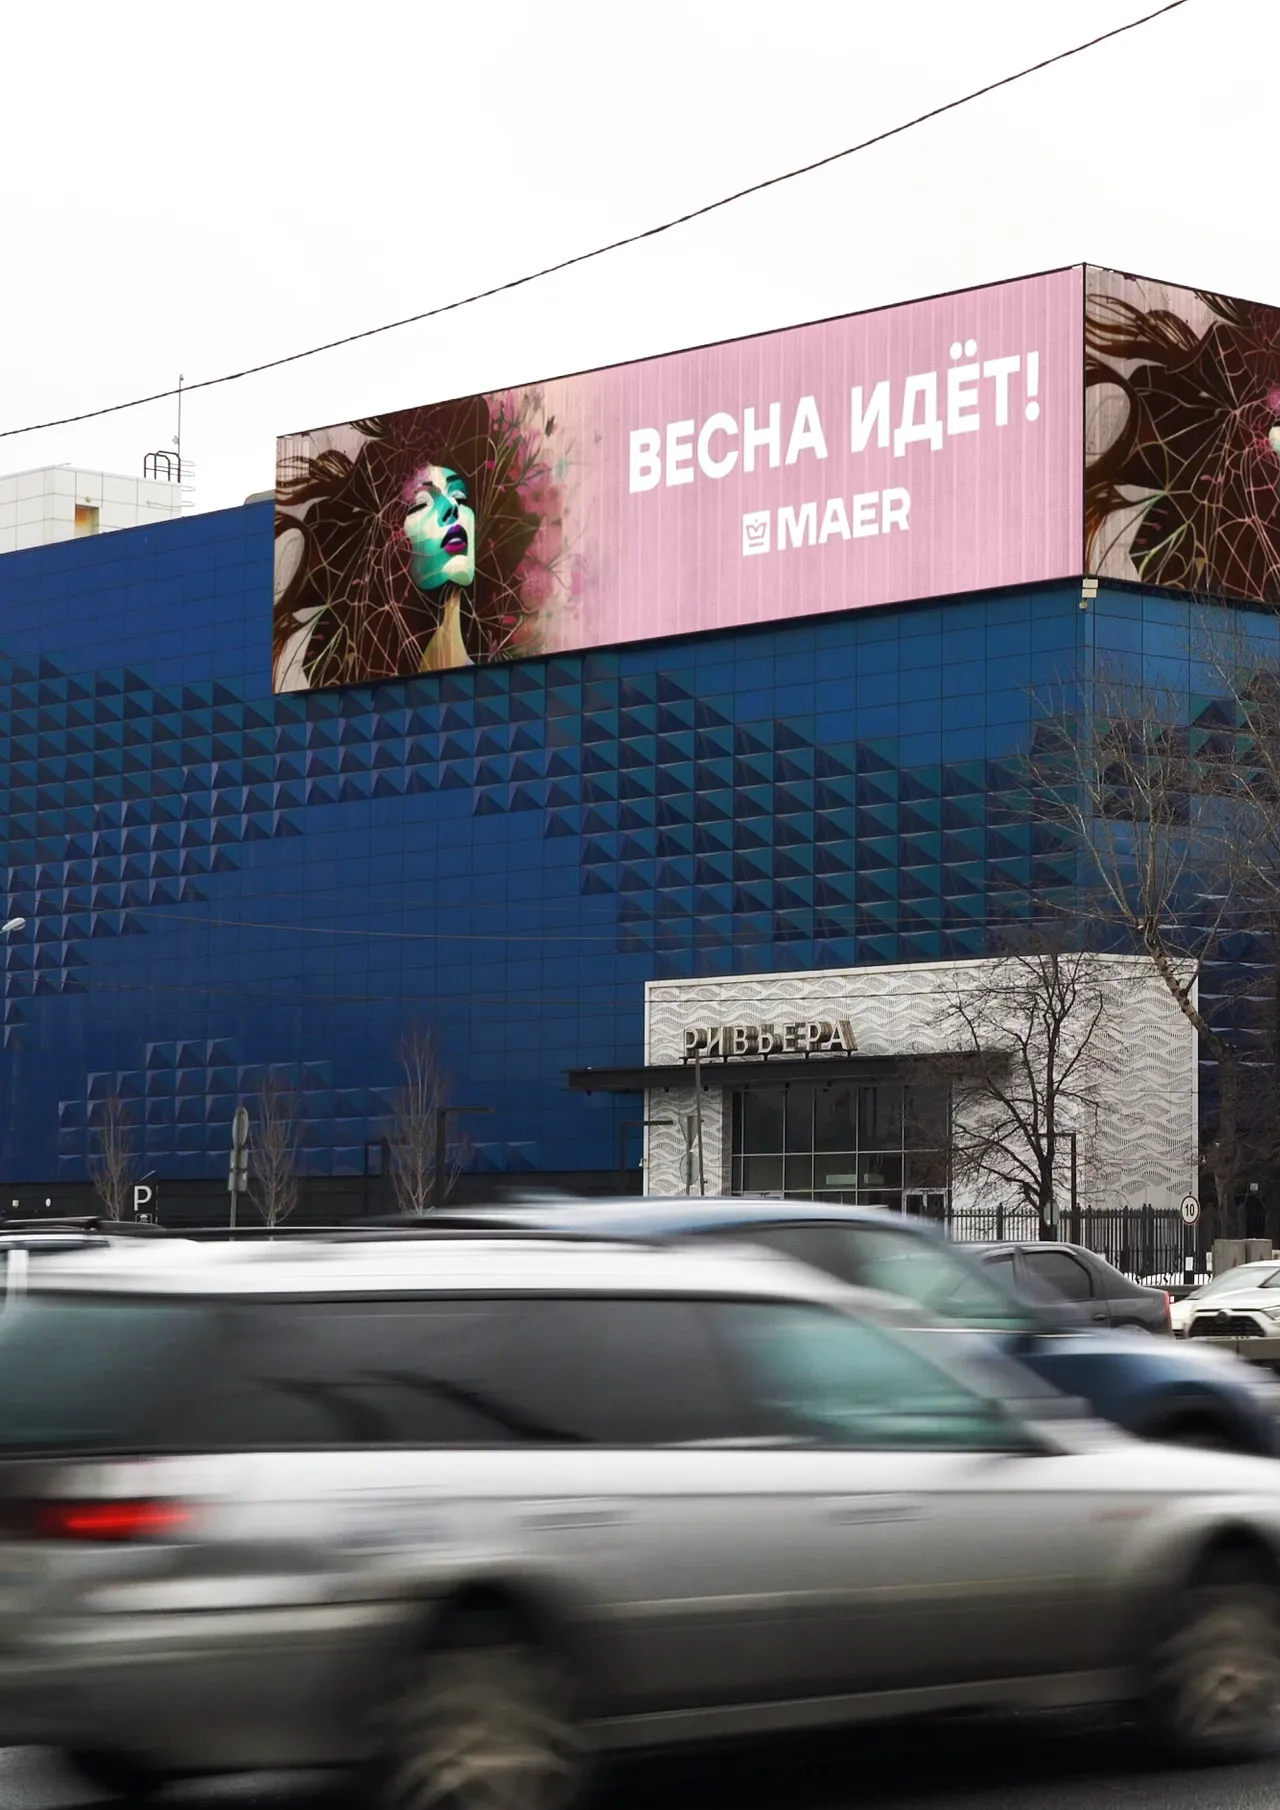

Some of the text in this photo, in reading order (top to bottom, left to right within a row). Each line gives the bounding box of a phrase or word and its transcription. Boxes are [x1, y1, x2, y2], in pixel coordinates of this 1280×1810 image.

[629, 338, 1040, 493] ВЕСНА ИДЁТ!
[777, 487, 911, 551] MAER
[684, 1020, 858, 1057] РИВЬЕРА
[134, 1185, 152, 1211] P
[1184, 1203, 1195, 1218] 10
